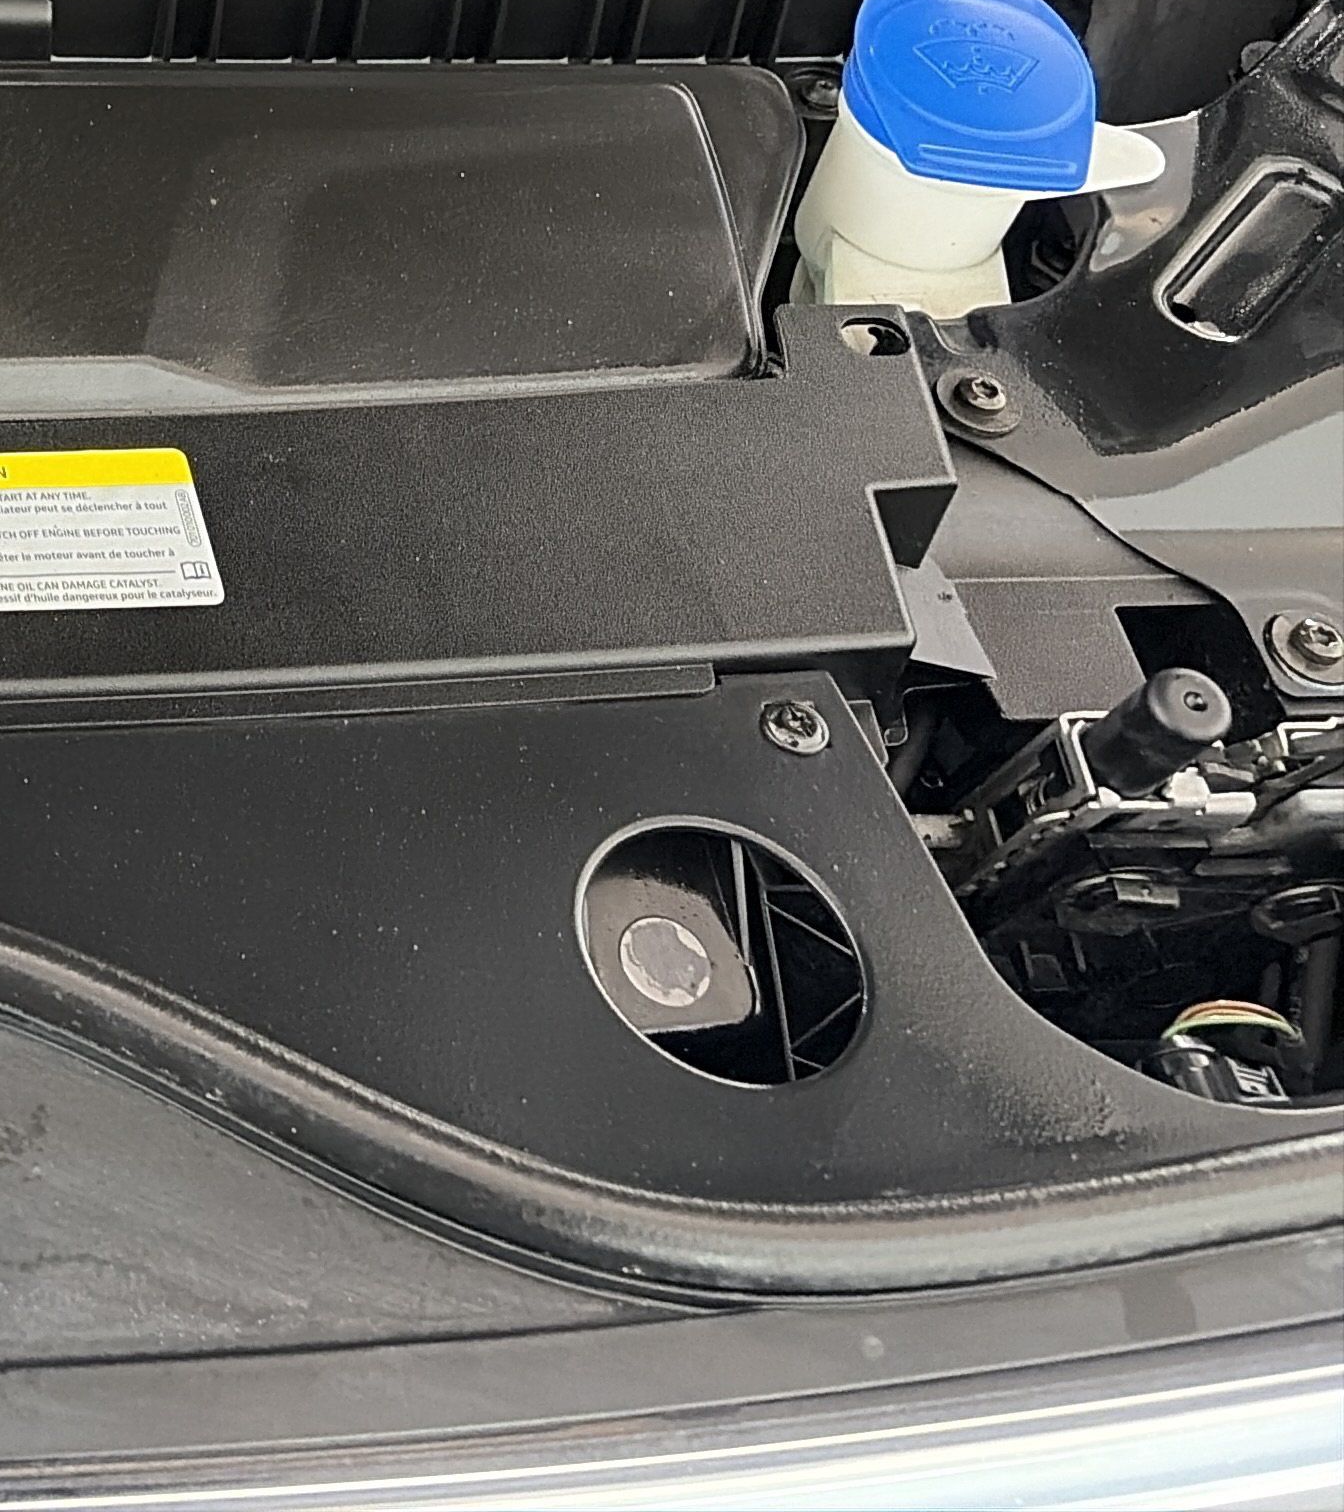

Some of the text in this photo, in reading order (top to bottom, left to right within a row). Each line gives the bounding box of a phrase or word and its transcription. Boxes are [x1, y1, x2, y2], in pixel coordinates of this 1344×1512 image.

[25, 492, 37, 501] AT
[40, 491, 61, 501] ANY
[34, 504, 58, 514] peut
[61, 505, 73, 513] se
[75, 501, 132, 513] déclencher
[135, 501, 142, 510] à
[144, 501, 167, 510] tout
[19, 529, 39, 538] OFF
[42, 527, 80, 538] ENGINE
[83, 527, 124, 537] BEFORE
[127, 525, 181, 536] TOUCHING
[21, 552, 32, 561] le
[34, 551, 74, 561] moteur
[77, 551, 105, 560] avant
[109, 550, 122, 559] de
[125, 548, 166, 559] toucher
[168, 547, 175, 557] à
[17, 582, 35, 591] OIL
[37, 581, 59, 591] CAN
[62, 580, 107, 590] DAMAGE
[24, 593, 59, 603] d'huile
[63, 591, 118, 603] dangereux
[122, 592, 144, 601] pour
[147, 590, 157, 599] le
[160, 589, 218, 600] catalyseur.
